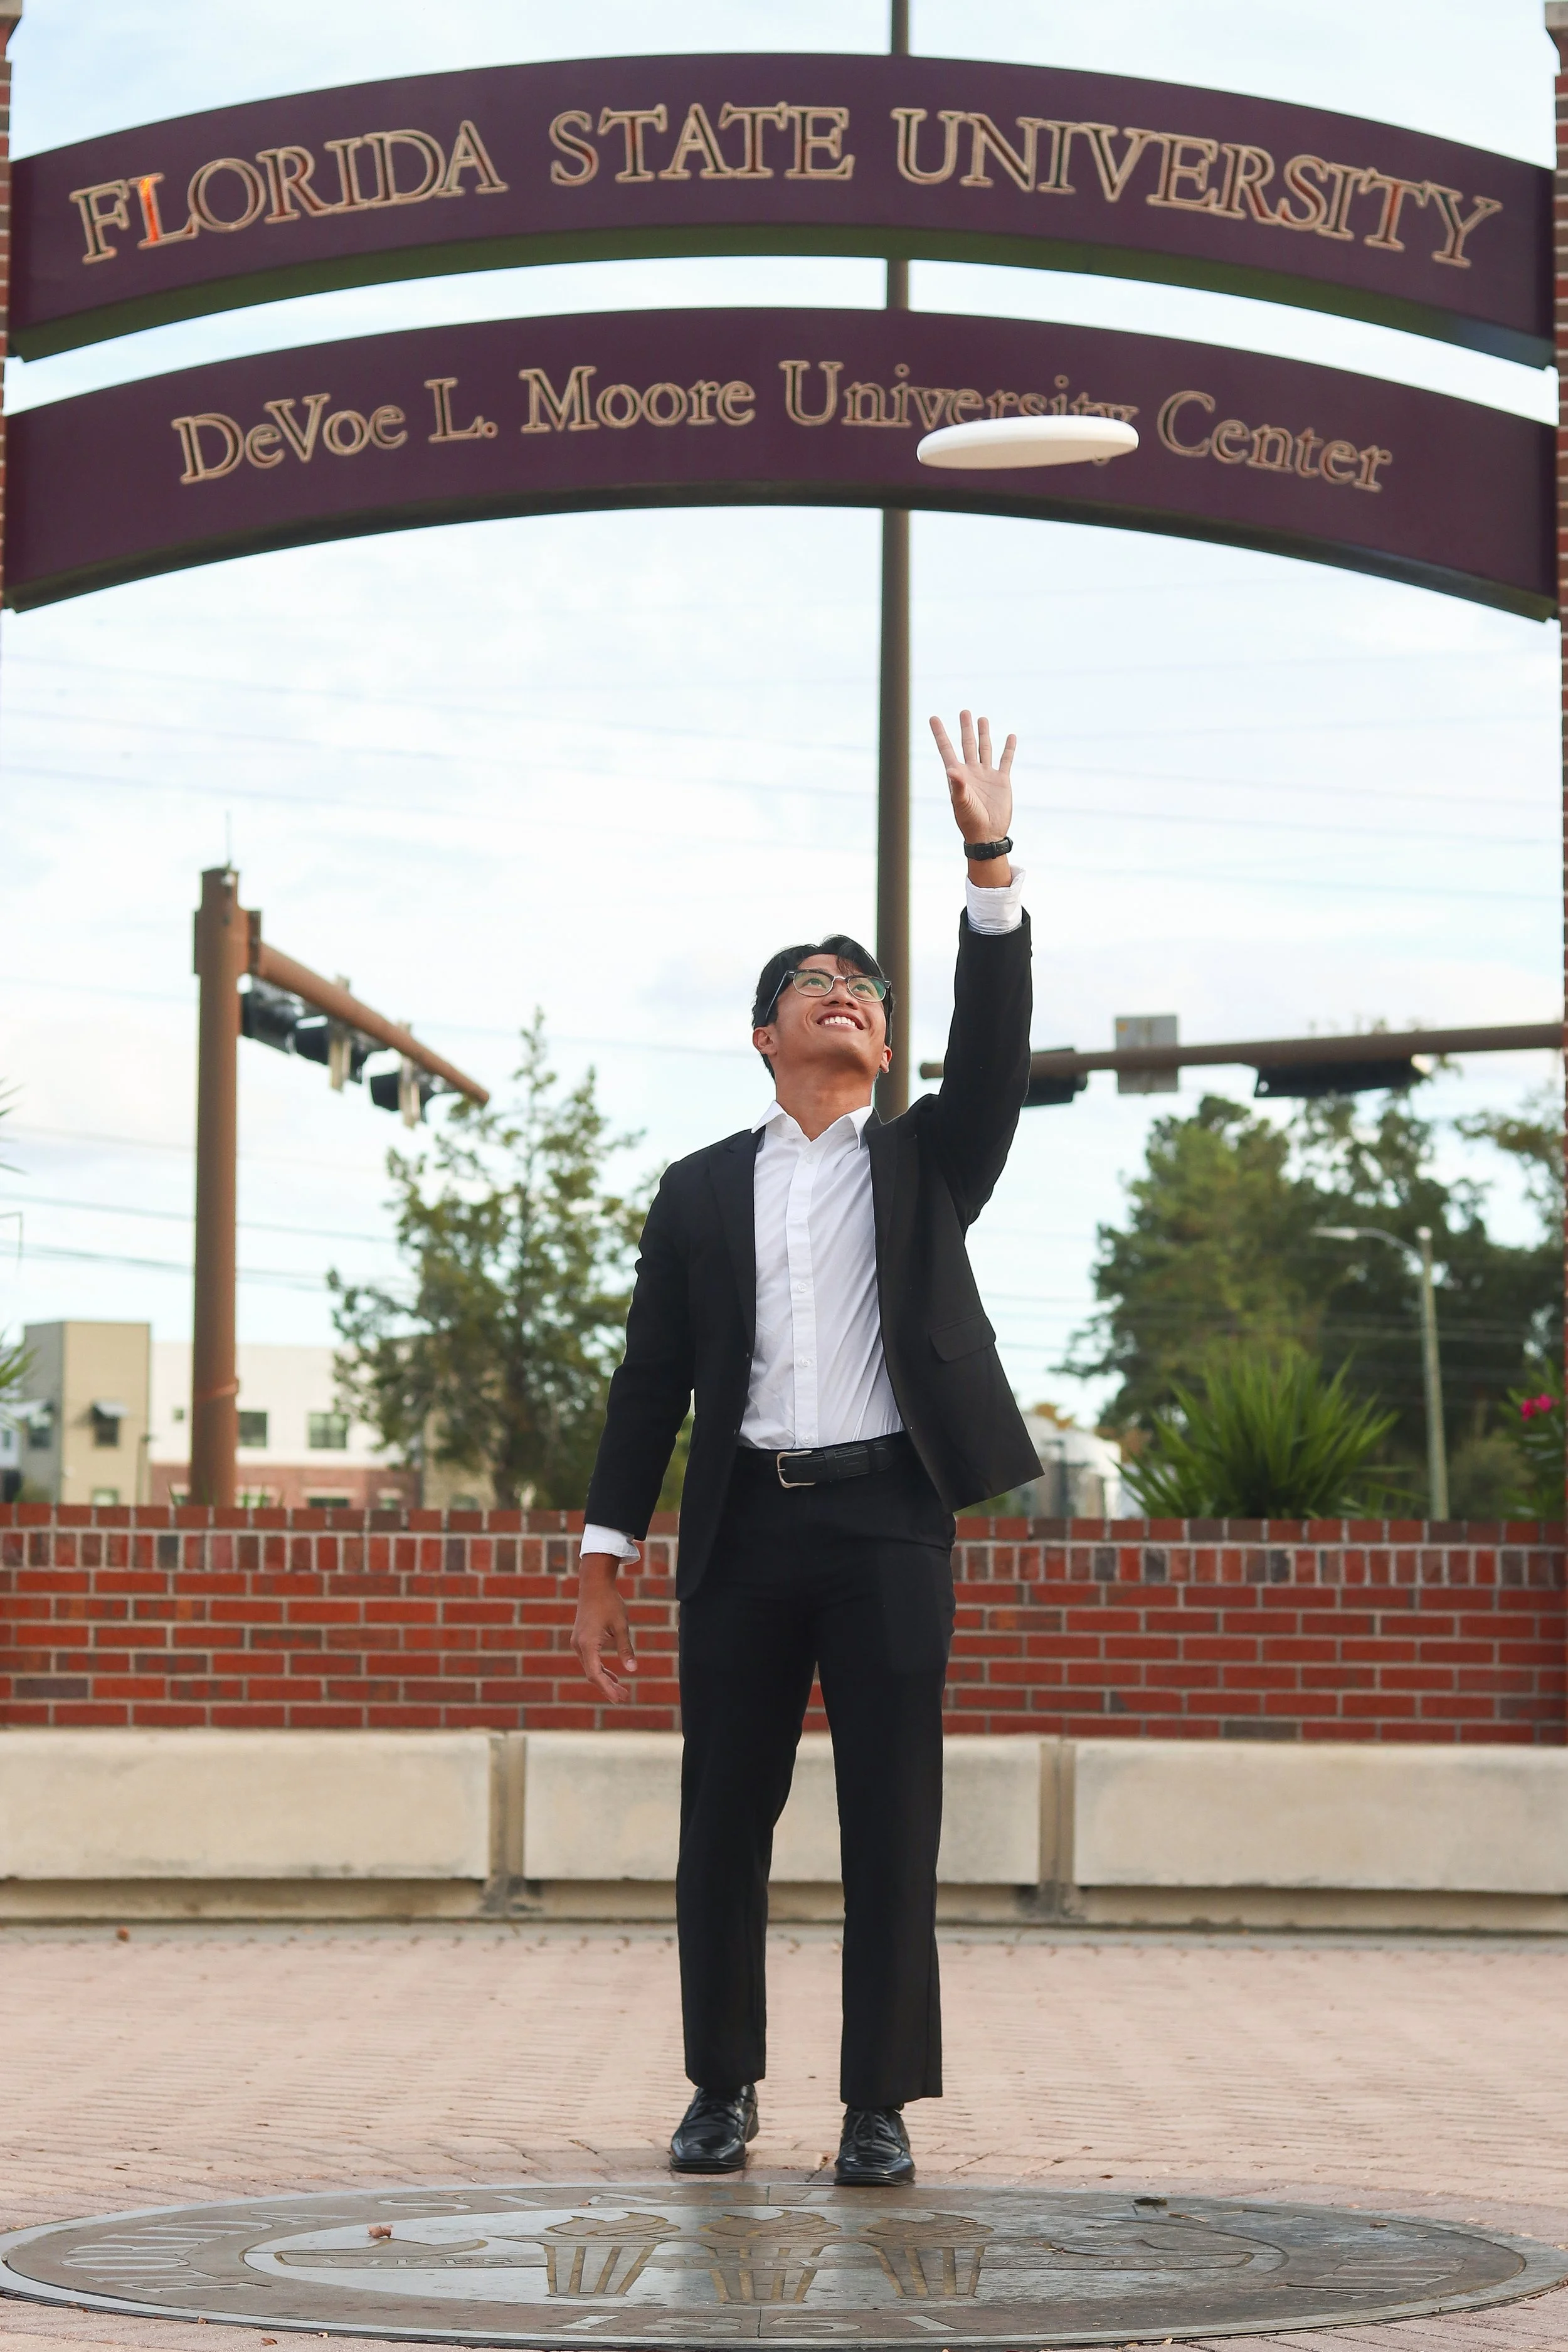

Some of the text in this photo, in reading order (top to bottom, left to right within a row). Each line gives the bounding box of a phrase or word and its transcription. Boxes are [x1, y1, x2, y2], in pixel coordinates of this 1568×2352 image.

[70, 101, 1503, 268] FLORIDA STATE UNIVERSITY
[171, 393, 408, 485] DeVoe
[424, 377, 499, 443] L.
[519, 366, 756, 434] Moore
[1157, 389, 1392, 492] Center
[537, 2313, 980, 2334] 1851
